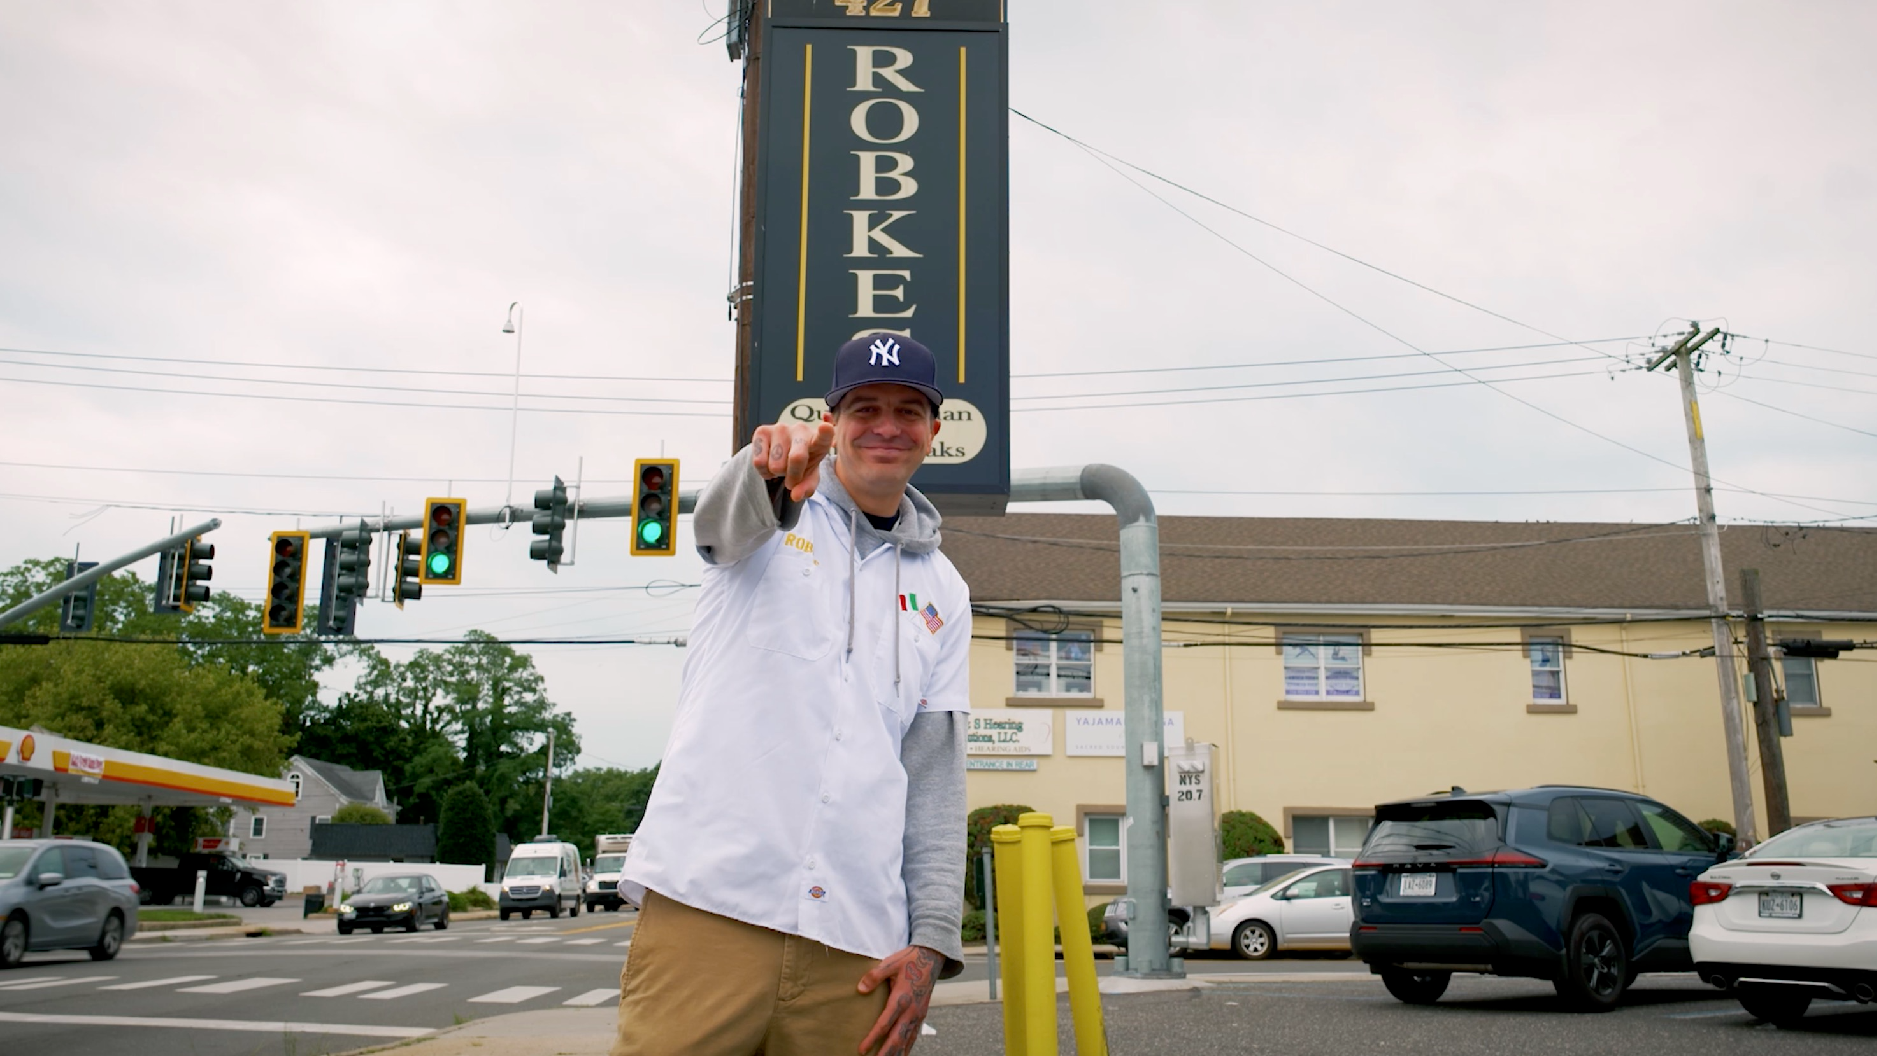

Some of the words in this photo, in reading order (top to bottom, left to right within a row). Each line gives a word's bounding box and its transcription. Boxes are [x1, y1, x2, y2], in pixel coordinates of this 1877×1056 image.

[843, 45, 925, 340] ROBKE
[983, 718, 1024, 732] Hearing
[1076, 717, 1125, 726] YAJAMA
[1179, 774, 1202, 786] NYS
[1177, 788, 1204, 802] 20.7
